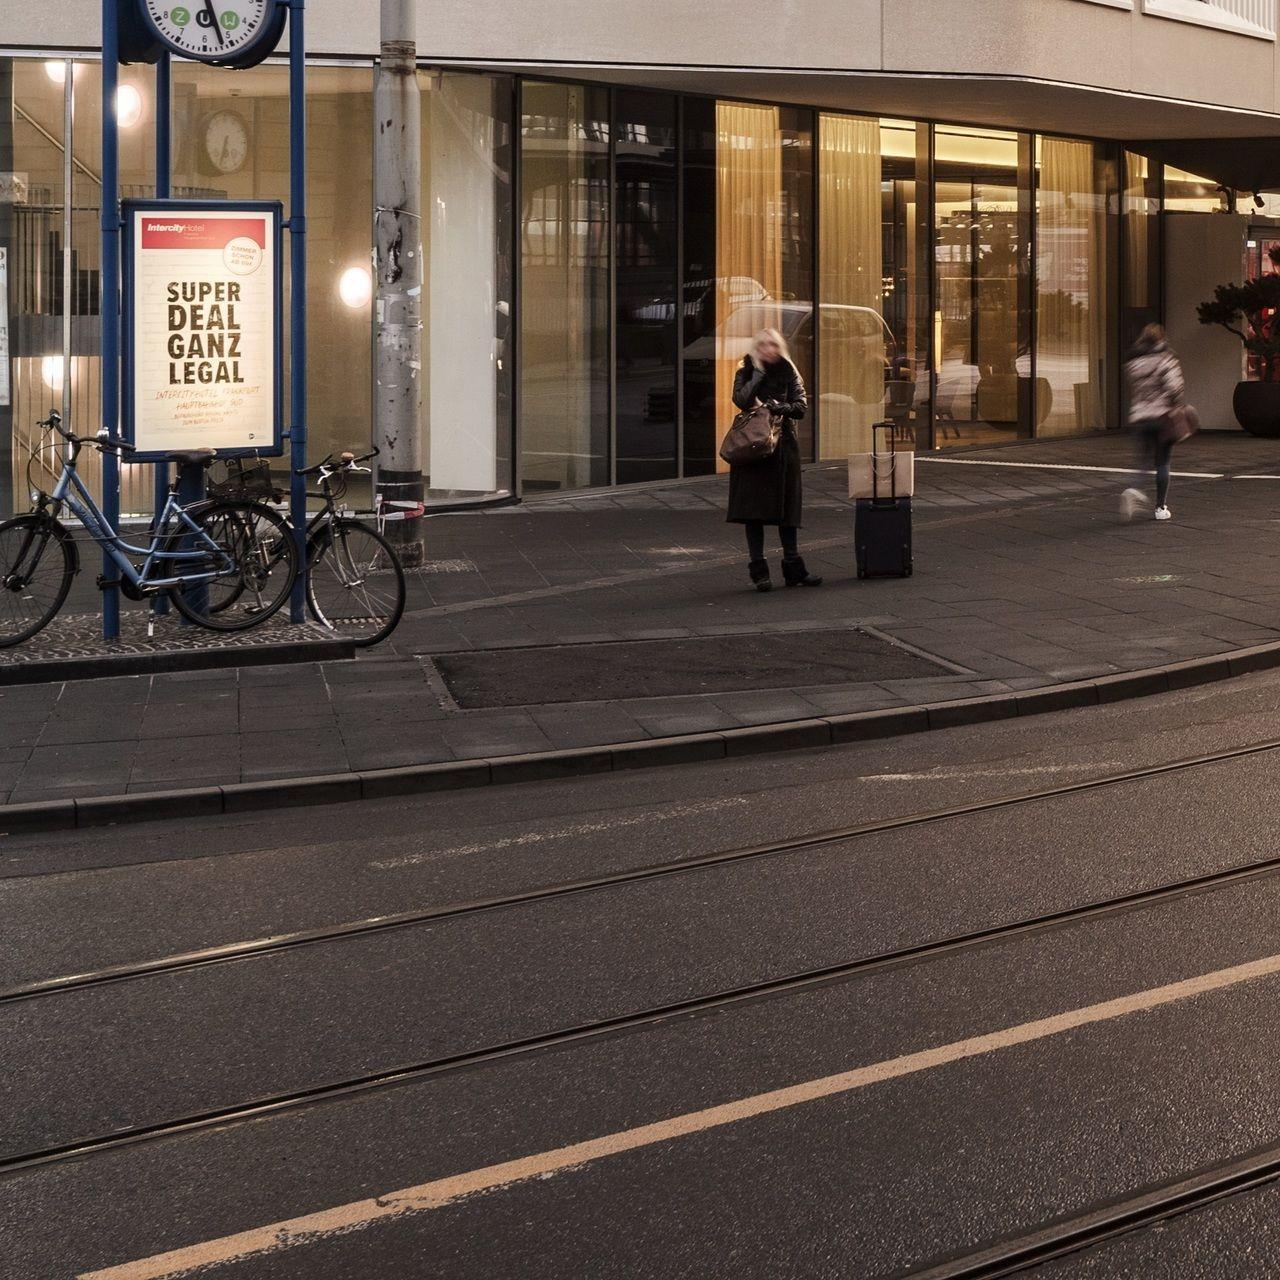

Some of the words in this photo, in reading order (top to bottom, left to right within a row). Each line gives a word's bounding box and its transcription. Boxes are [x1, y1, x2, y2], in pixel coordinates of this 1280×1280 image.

[163, 11, 168, 19] 8
[241, 17, 247, 25] 4
[202, 35, 208, 43] 6
[225, 30, 231, 39] 5
[167, 281, 241, 303] SUPER
[168, 304, 241, 332] DEAL
[167, 332, 242, 360] GANZ
[169, 360, 245, 386] LEGAL
